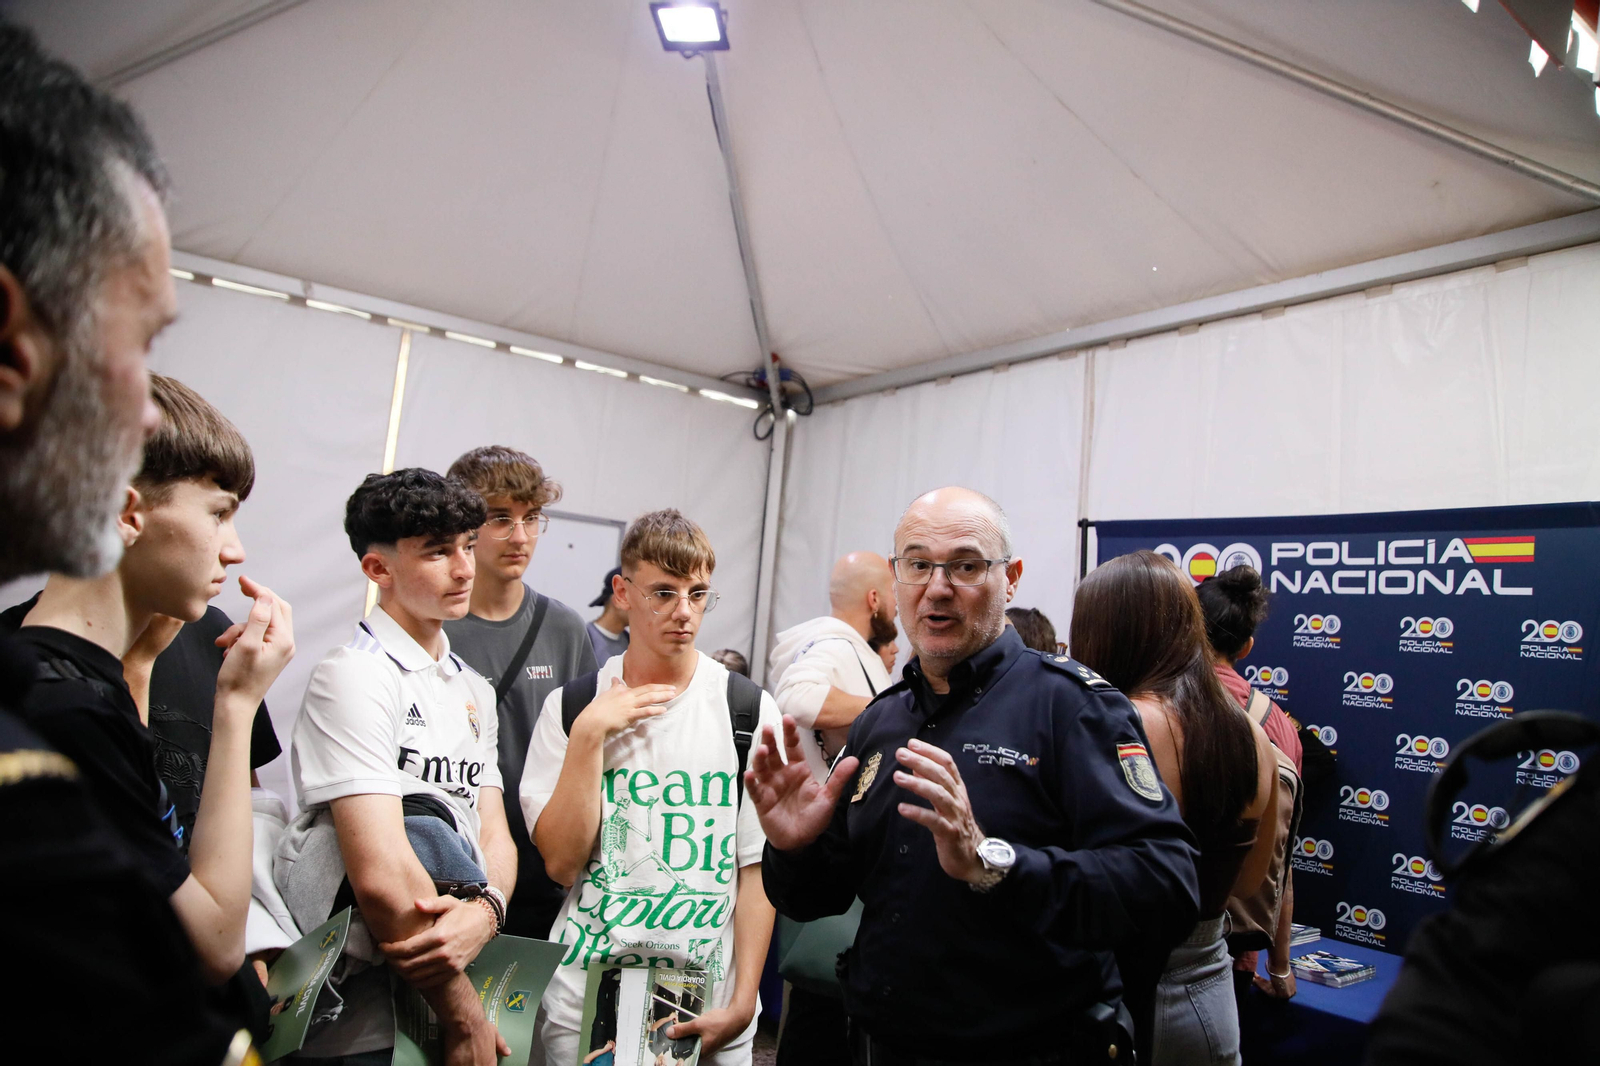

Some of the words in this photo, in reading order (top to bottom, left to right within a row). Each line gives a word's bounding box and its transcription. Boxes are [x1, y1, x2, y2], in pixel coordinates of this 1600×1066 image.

[1270, 569, 1533, 596] NACIONAL
[1294, 613, 1341, 635] 200
[1400, 616, 1454, 638] 200
[1521, 619, 1583, 644] 200
[1293, 641, 1341, 649] NACIONAL
[1399, 646, 1453, 654] NACIONAL
[1520, 652, 1582, 660] NACIONAL
[1245, 665, 1289, 686] 200
[1343, 671, 1394, 694] 200
[1456, 678, 1514, 703] 200
[1342, 700, 1393, 710] NACIONAL
[1455, 709, 1513, 719] NACIONAL
[405, 718, 427, 728] adidas
[1396, 733, 1449, 758] 200
[978, 755, 1016, 767] CNP
[1516, 749, 1580, 774] 200
[601, 766, 738, 807] ream
[1340, 785, 1390, 811] 200
[1338, 814, 1389, 827] NACIONAL
[1452, 801, 1510, 829] 200
[657, 812, 737, 885] Big
[1391, 883, 1445, 899] NACIONAL
[1336, 902, 1386, 930] 200
[620, 938, 644, 948] Seek
[645, 940, 680, 950] Orizons
[1335, 930, 1386, 947] NACIONAL
[659, 973, 676, 982] CIVIL
[676, 975, 705, 984] GUARDIA
[295, 988, 313, 1018] CIVIL
